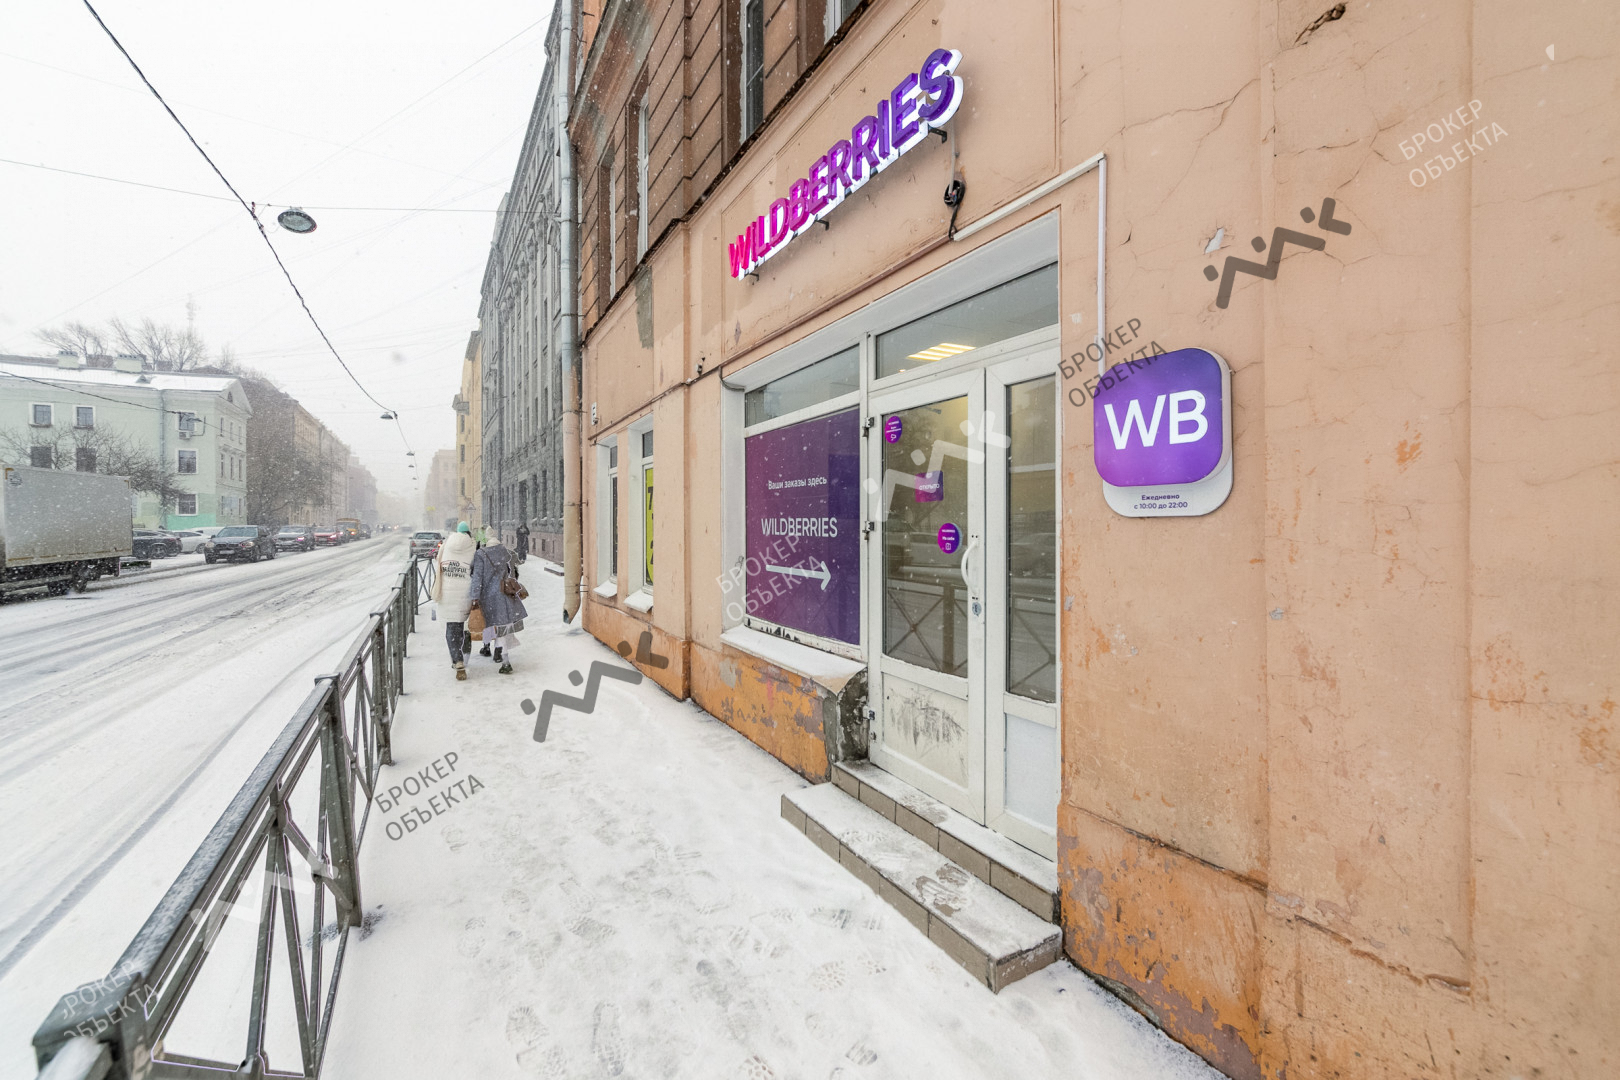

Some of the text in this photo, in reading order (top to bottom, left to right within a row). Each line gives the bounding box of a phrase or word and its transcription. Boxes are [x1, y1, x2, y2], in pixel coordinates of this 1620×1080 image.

[728, 48, 963, 279] WILDBERRIES
[1103, 389, 1209, 450] WB
[768, 477, 827, 490] Ваши заказы здесь
[761, 517, 838, 538] WILDBERRIES
